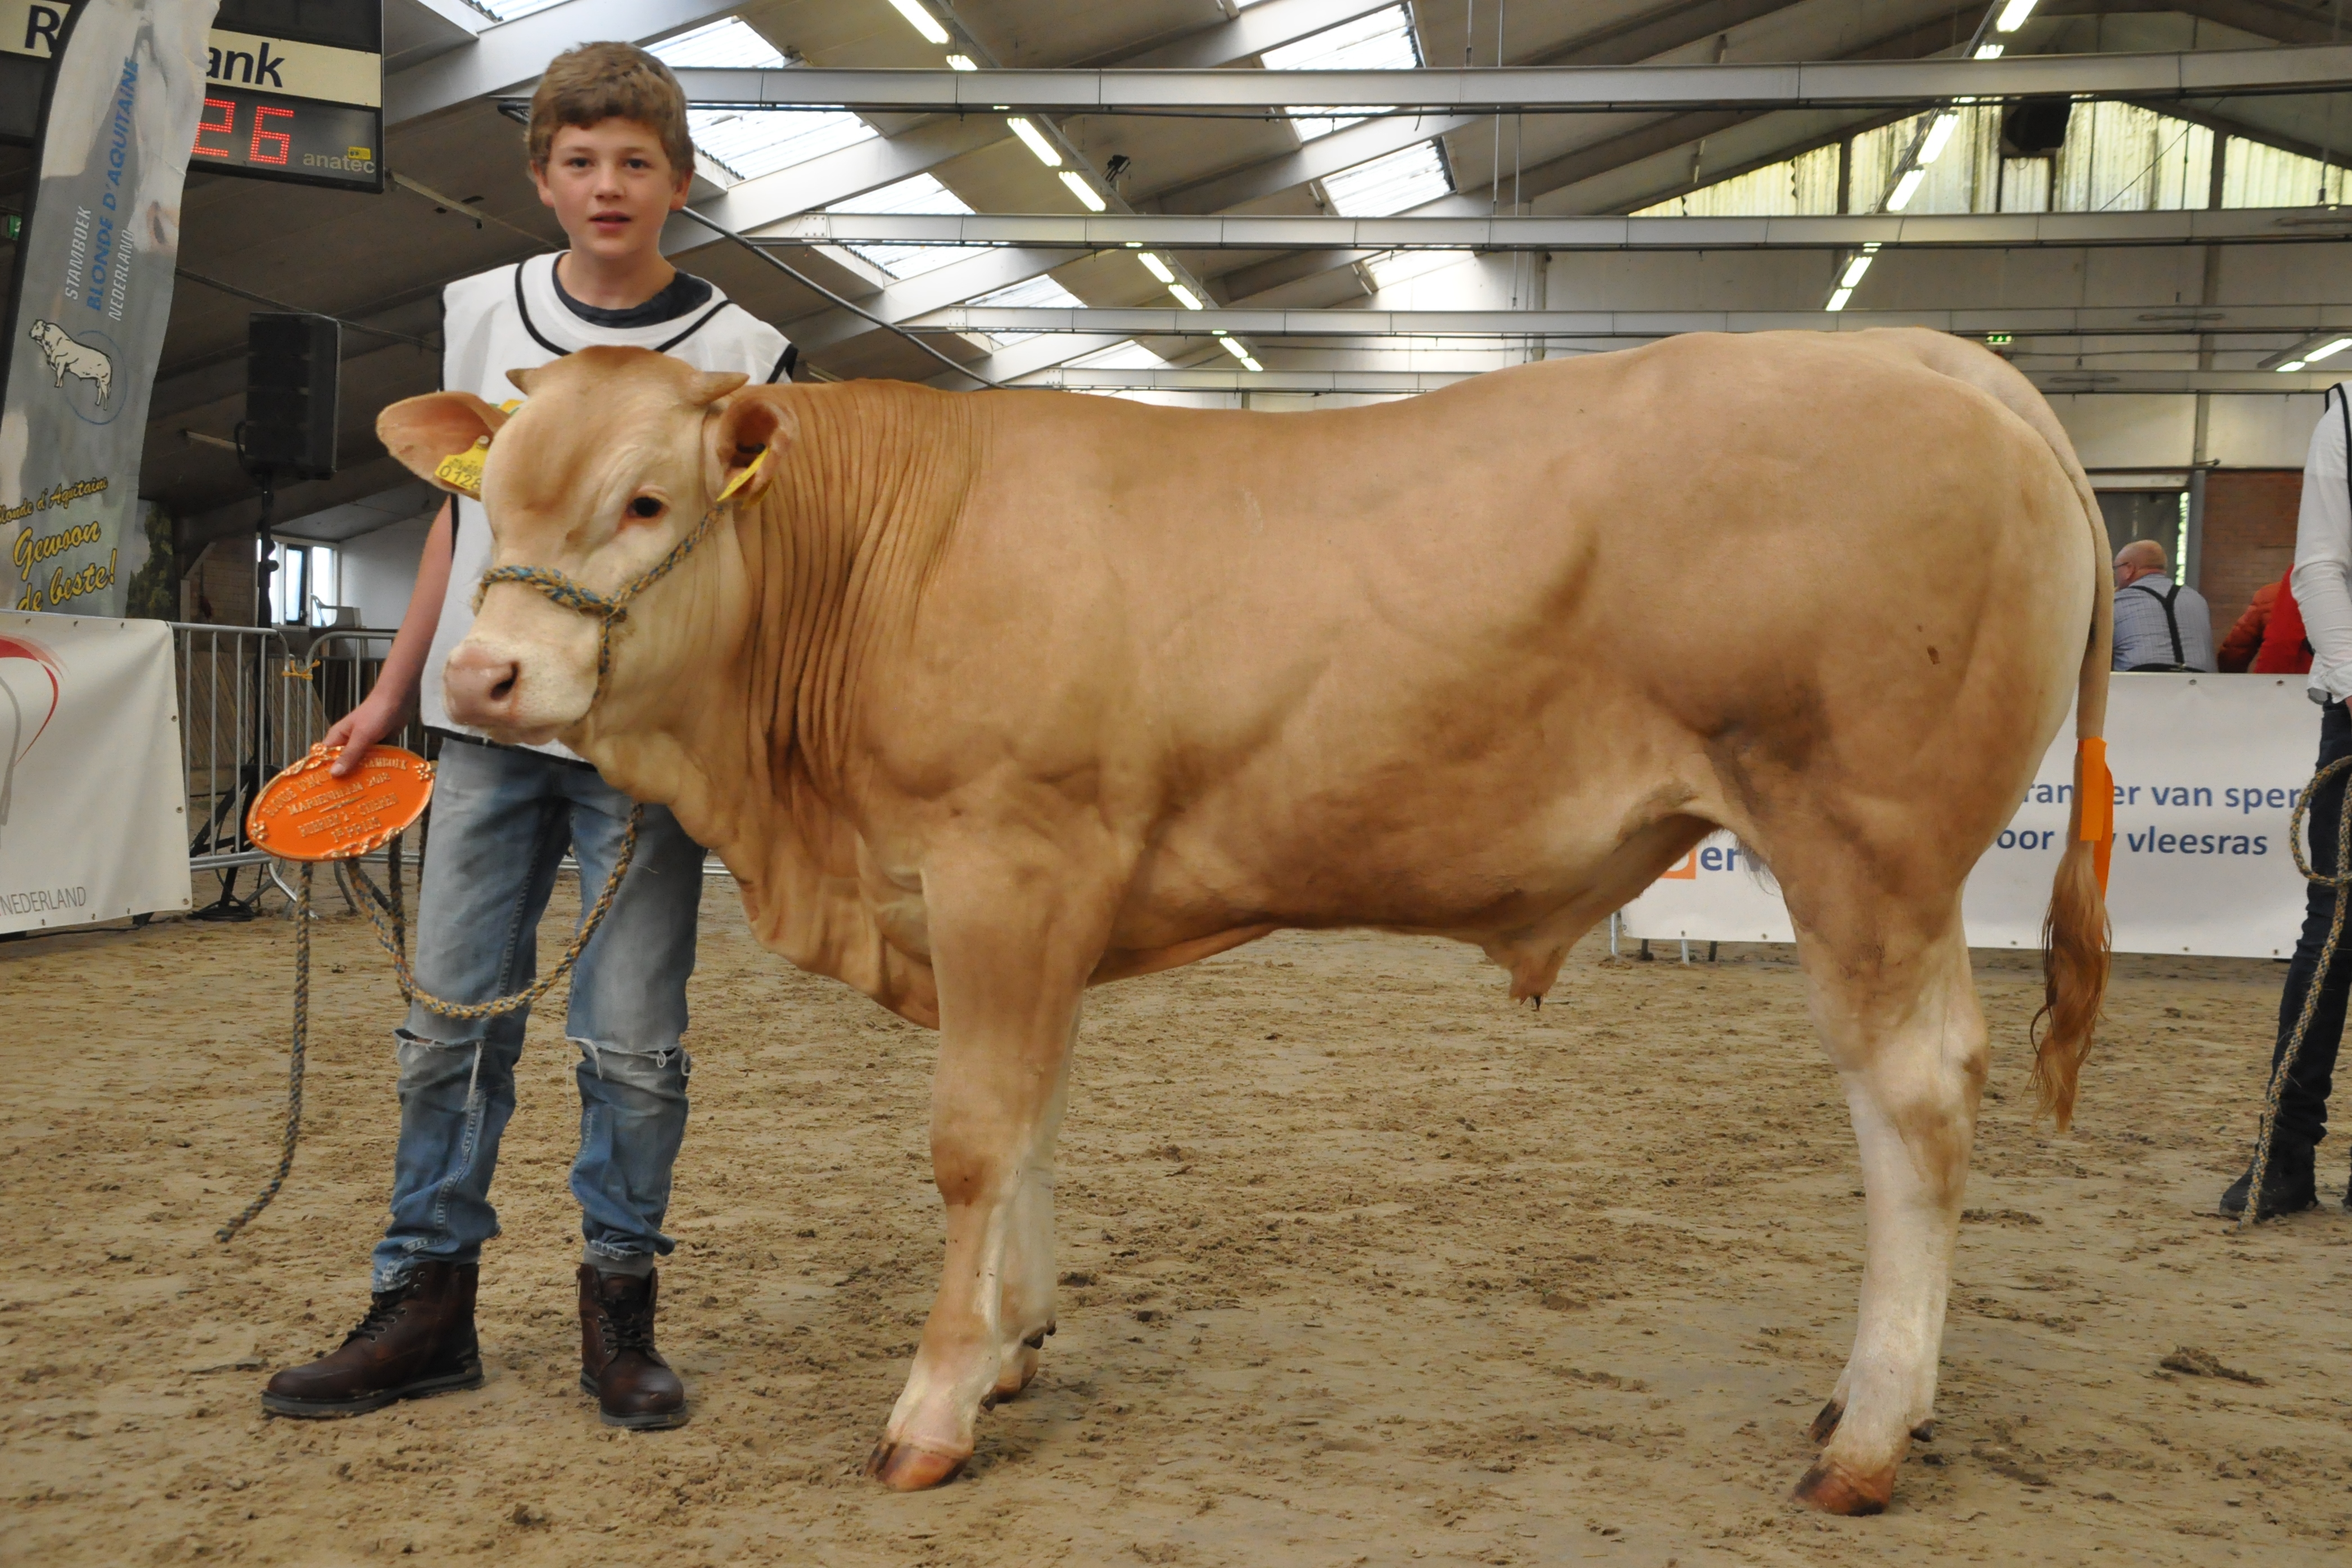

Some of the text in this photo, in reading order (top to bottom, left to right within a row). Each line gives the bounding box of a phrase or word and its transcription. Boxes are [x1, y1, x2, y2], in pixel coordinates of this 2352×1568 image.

[87, 56, 138, 310] BLONDE D'AQUITAINE
[303, 153, 375, 174] anatec
[65, 206, 91, 300] STAMBOEK
[109, 229, 134, 321] NEDERLAND
[13, 521, 102, 581] Gewoon
[17, 548, 117, 611] de beste!
[2151, 785, 2213, 807] van
[2224, 787, 2312, 814] sper
[1997, 829, 2055, 849] oor
[2127, 826, 2268, 855] vleesras
[0, 886, 86, 915] NEDERLAND
